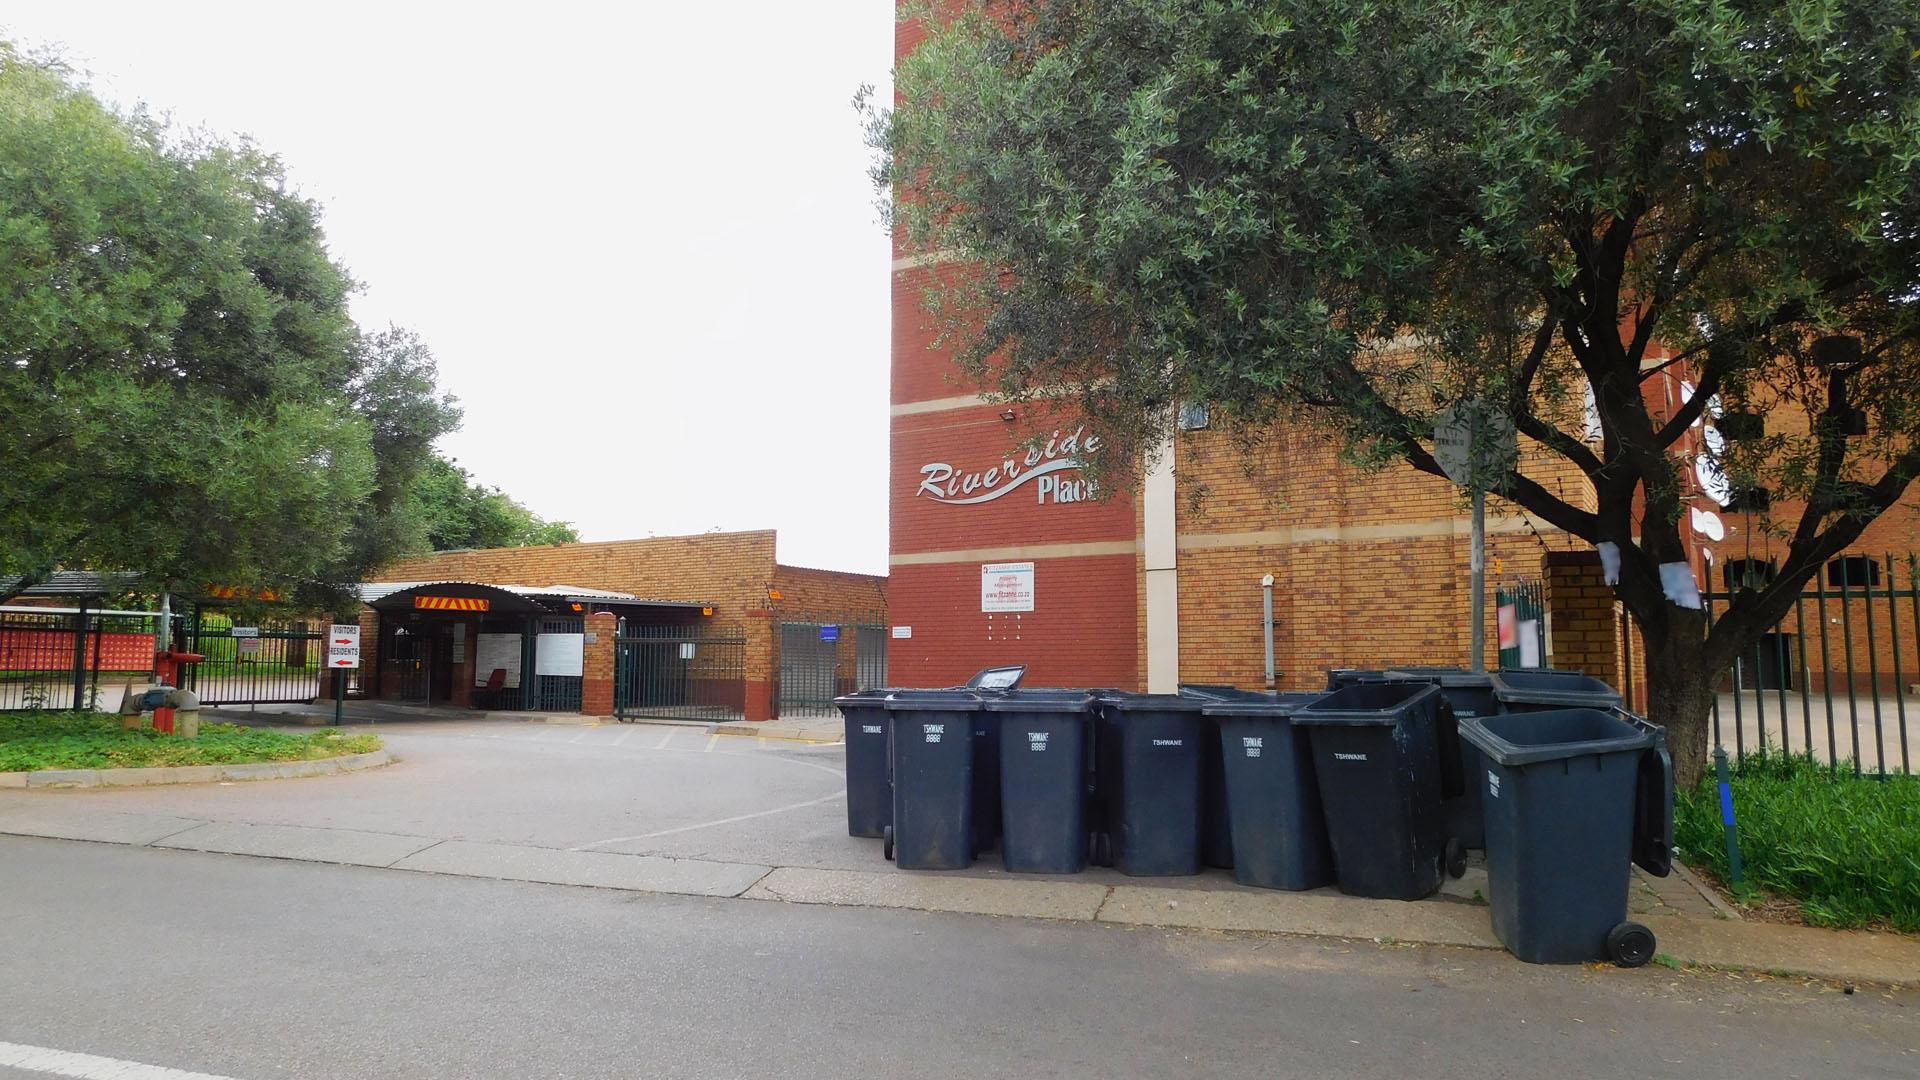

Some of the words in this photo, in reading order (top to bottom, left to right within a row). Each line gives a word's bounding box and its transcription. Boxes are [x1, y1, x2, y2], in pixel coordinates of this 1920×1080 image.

[916, 425, 1102, 498] Riverside
[333, 626, 357, 635] VISITORS
[330, 647, 359, 656] RESIDENTS
[923, 724, 945, 734] TSHWANE
[1028, 732, 1049, 742] TSHWANE
[1334, 752, 1368, 761] TSHWANE
